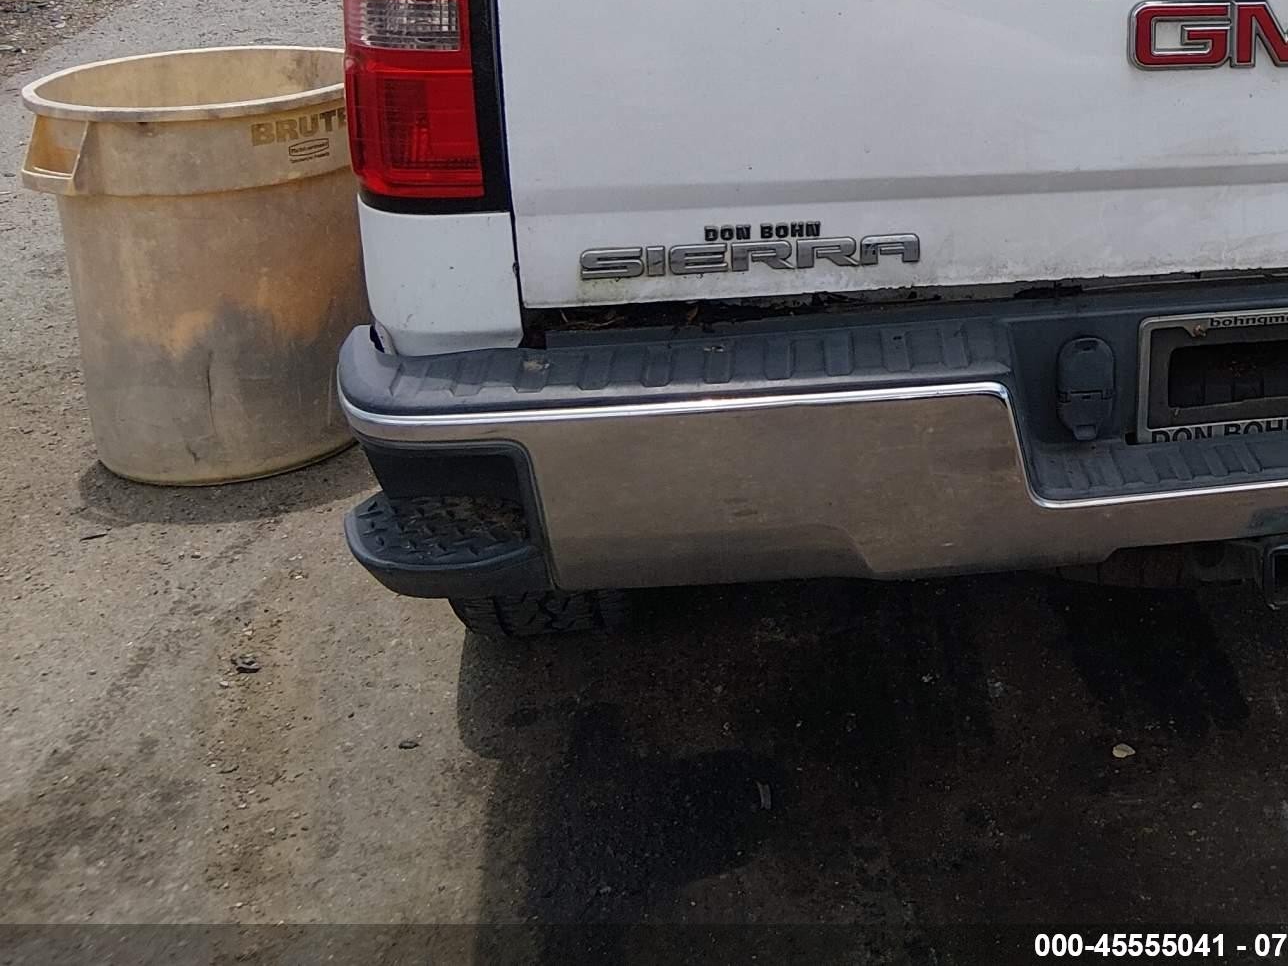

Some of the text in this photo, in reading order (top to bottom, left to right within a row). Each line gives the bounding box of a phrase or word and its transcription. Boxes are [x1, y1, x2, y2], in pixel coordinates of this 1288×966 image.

[704, 221, 821, 242] DON BOHN
[580, 233, 920, 280] SIERRA
